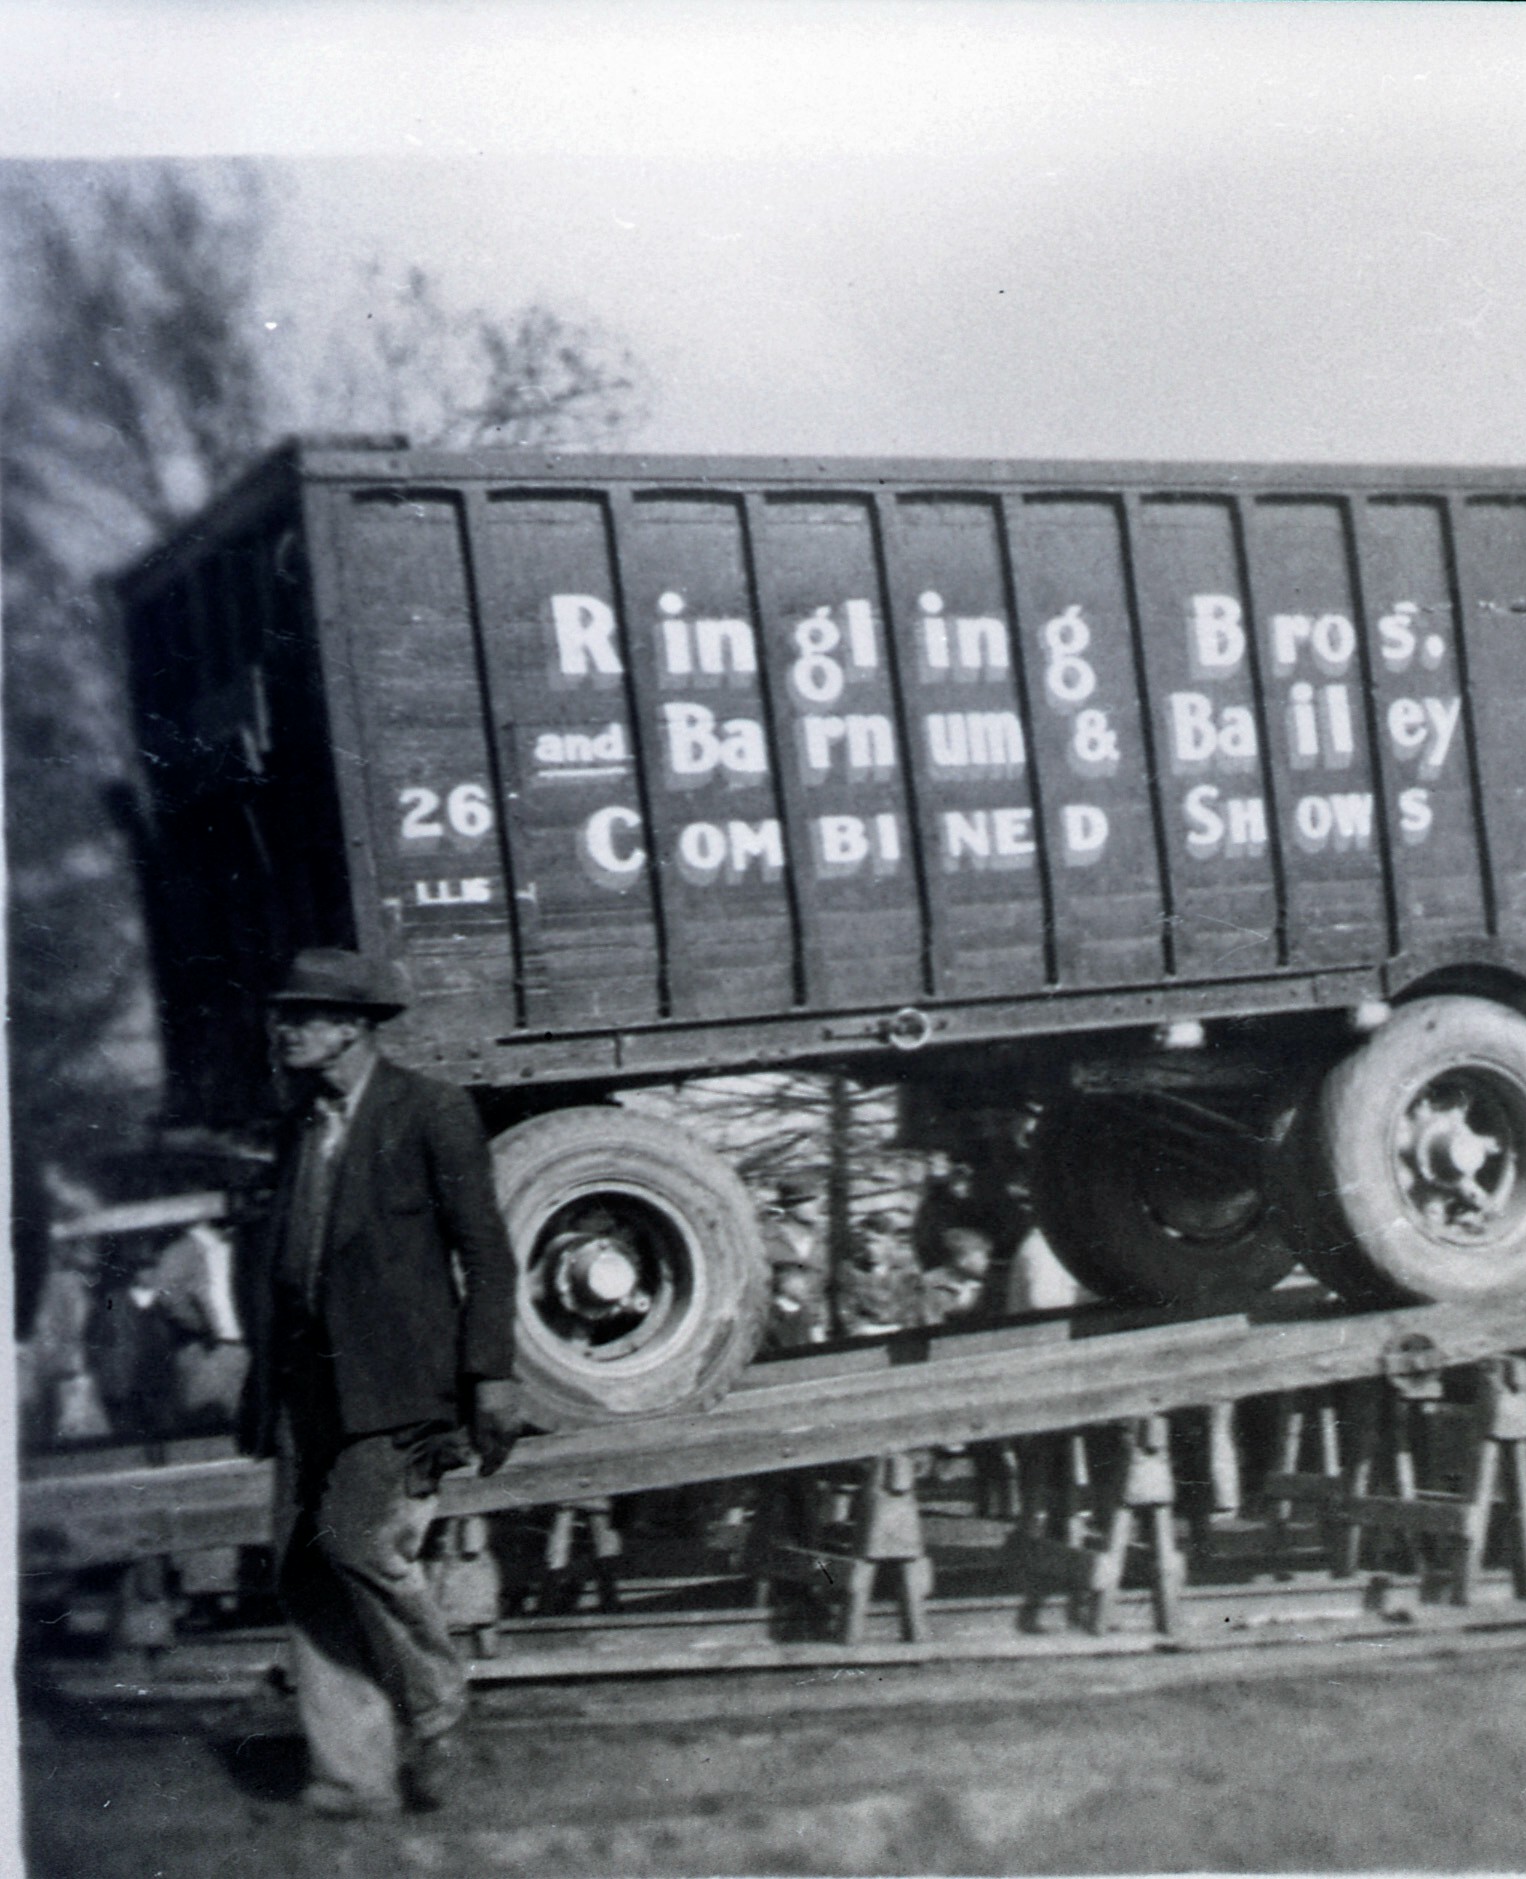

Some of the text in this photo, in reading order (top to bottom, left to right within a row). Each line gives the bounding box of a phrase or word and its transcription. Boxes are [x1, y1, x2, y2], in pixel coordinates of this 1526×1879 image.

[549, 593, 1446, 702] Ringling Bros.
[534, 682, 1462, 774] and Barnum & Bailey
[400, 783, 494, 839] 26
[586, 784, 1434, 874] COMBINED SHOWS
